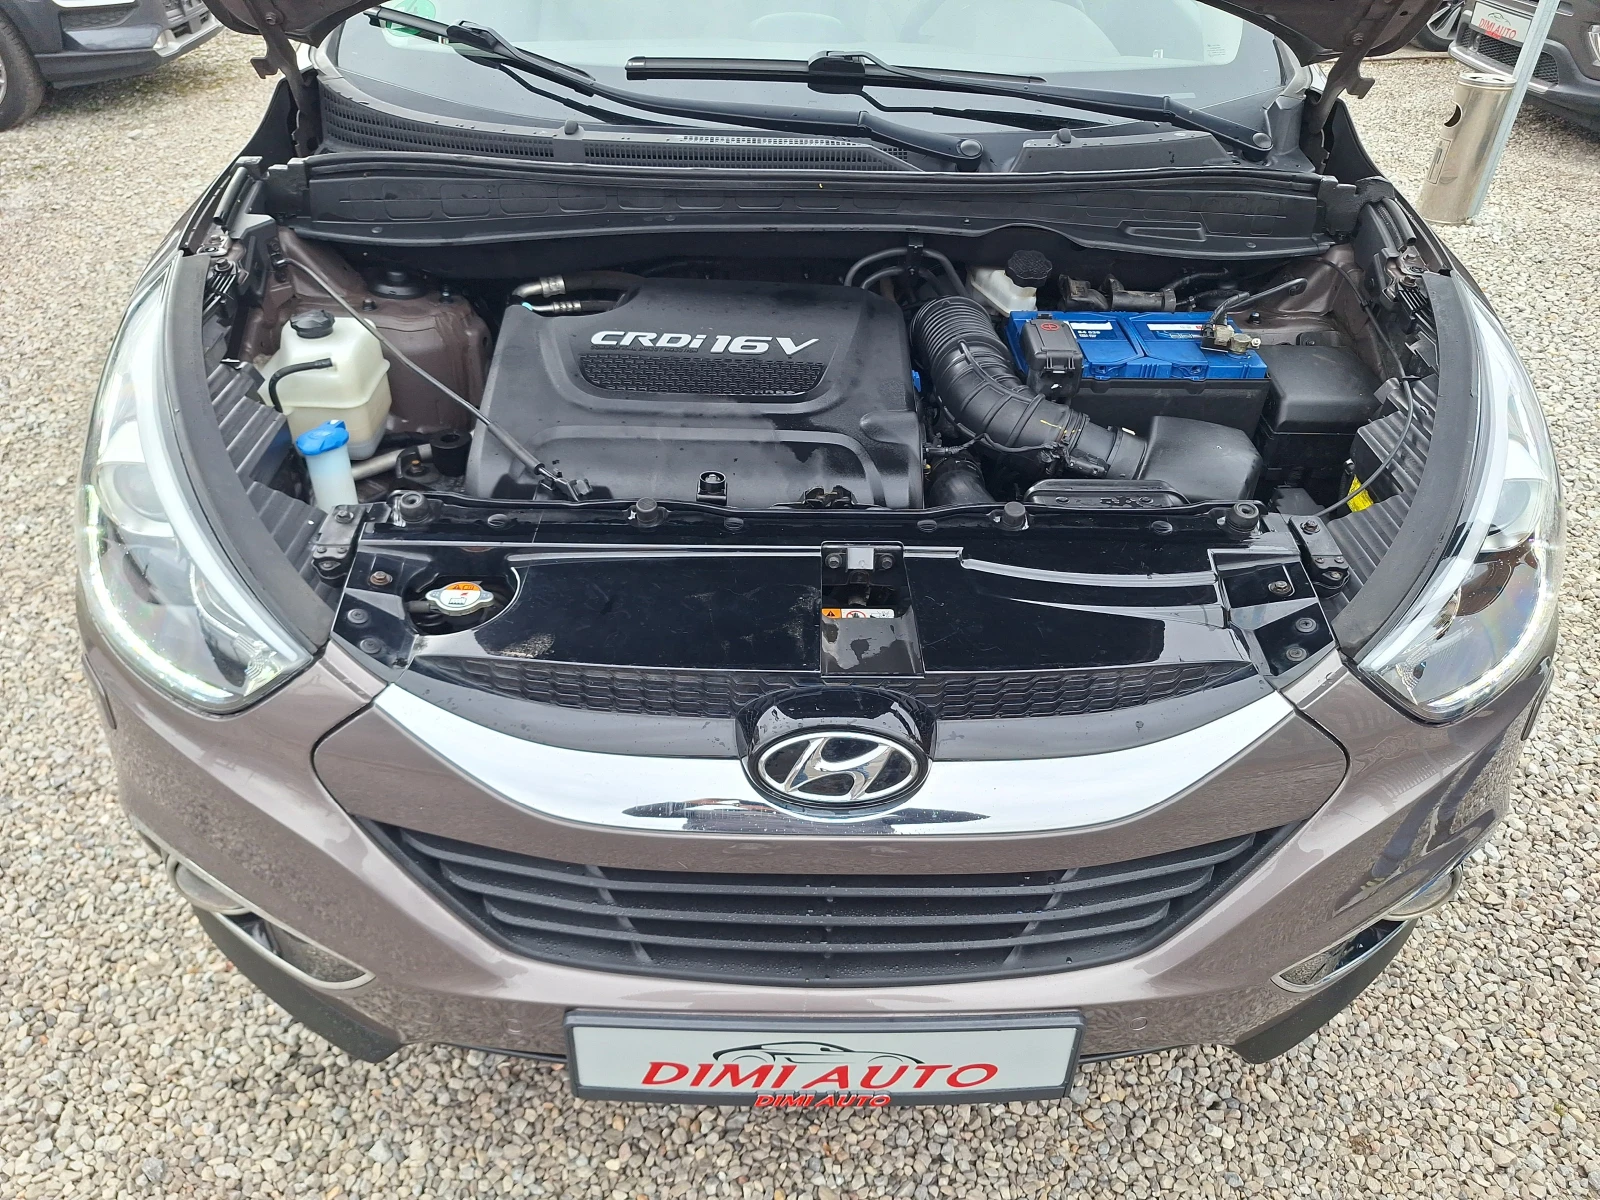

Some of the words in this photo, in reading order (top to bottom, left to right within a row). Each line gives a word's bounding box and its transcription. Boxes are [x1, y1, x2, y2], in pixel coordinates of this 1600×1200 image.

[1478, 18, 1496, 32] DIMI
[1493, 25, 1517, 40] AUTO
[641, 1061, 797, 1090] DIMI
[801, 1063, 999, 1090] AUTO
[754, 1094, 816, 1108] DIMI
[815, 1094, 892, 1108] AUTO
